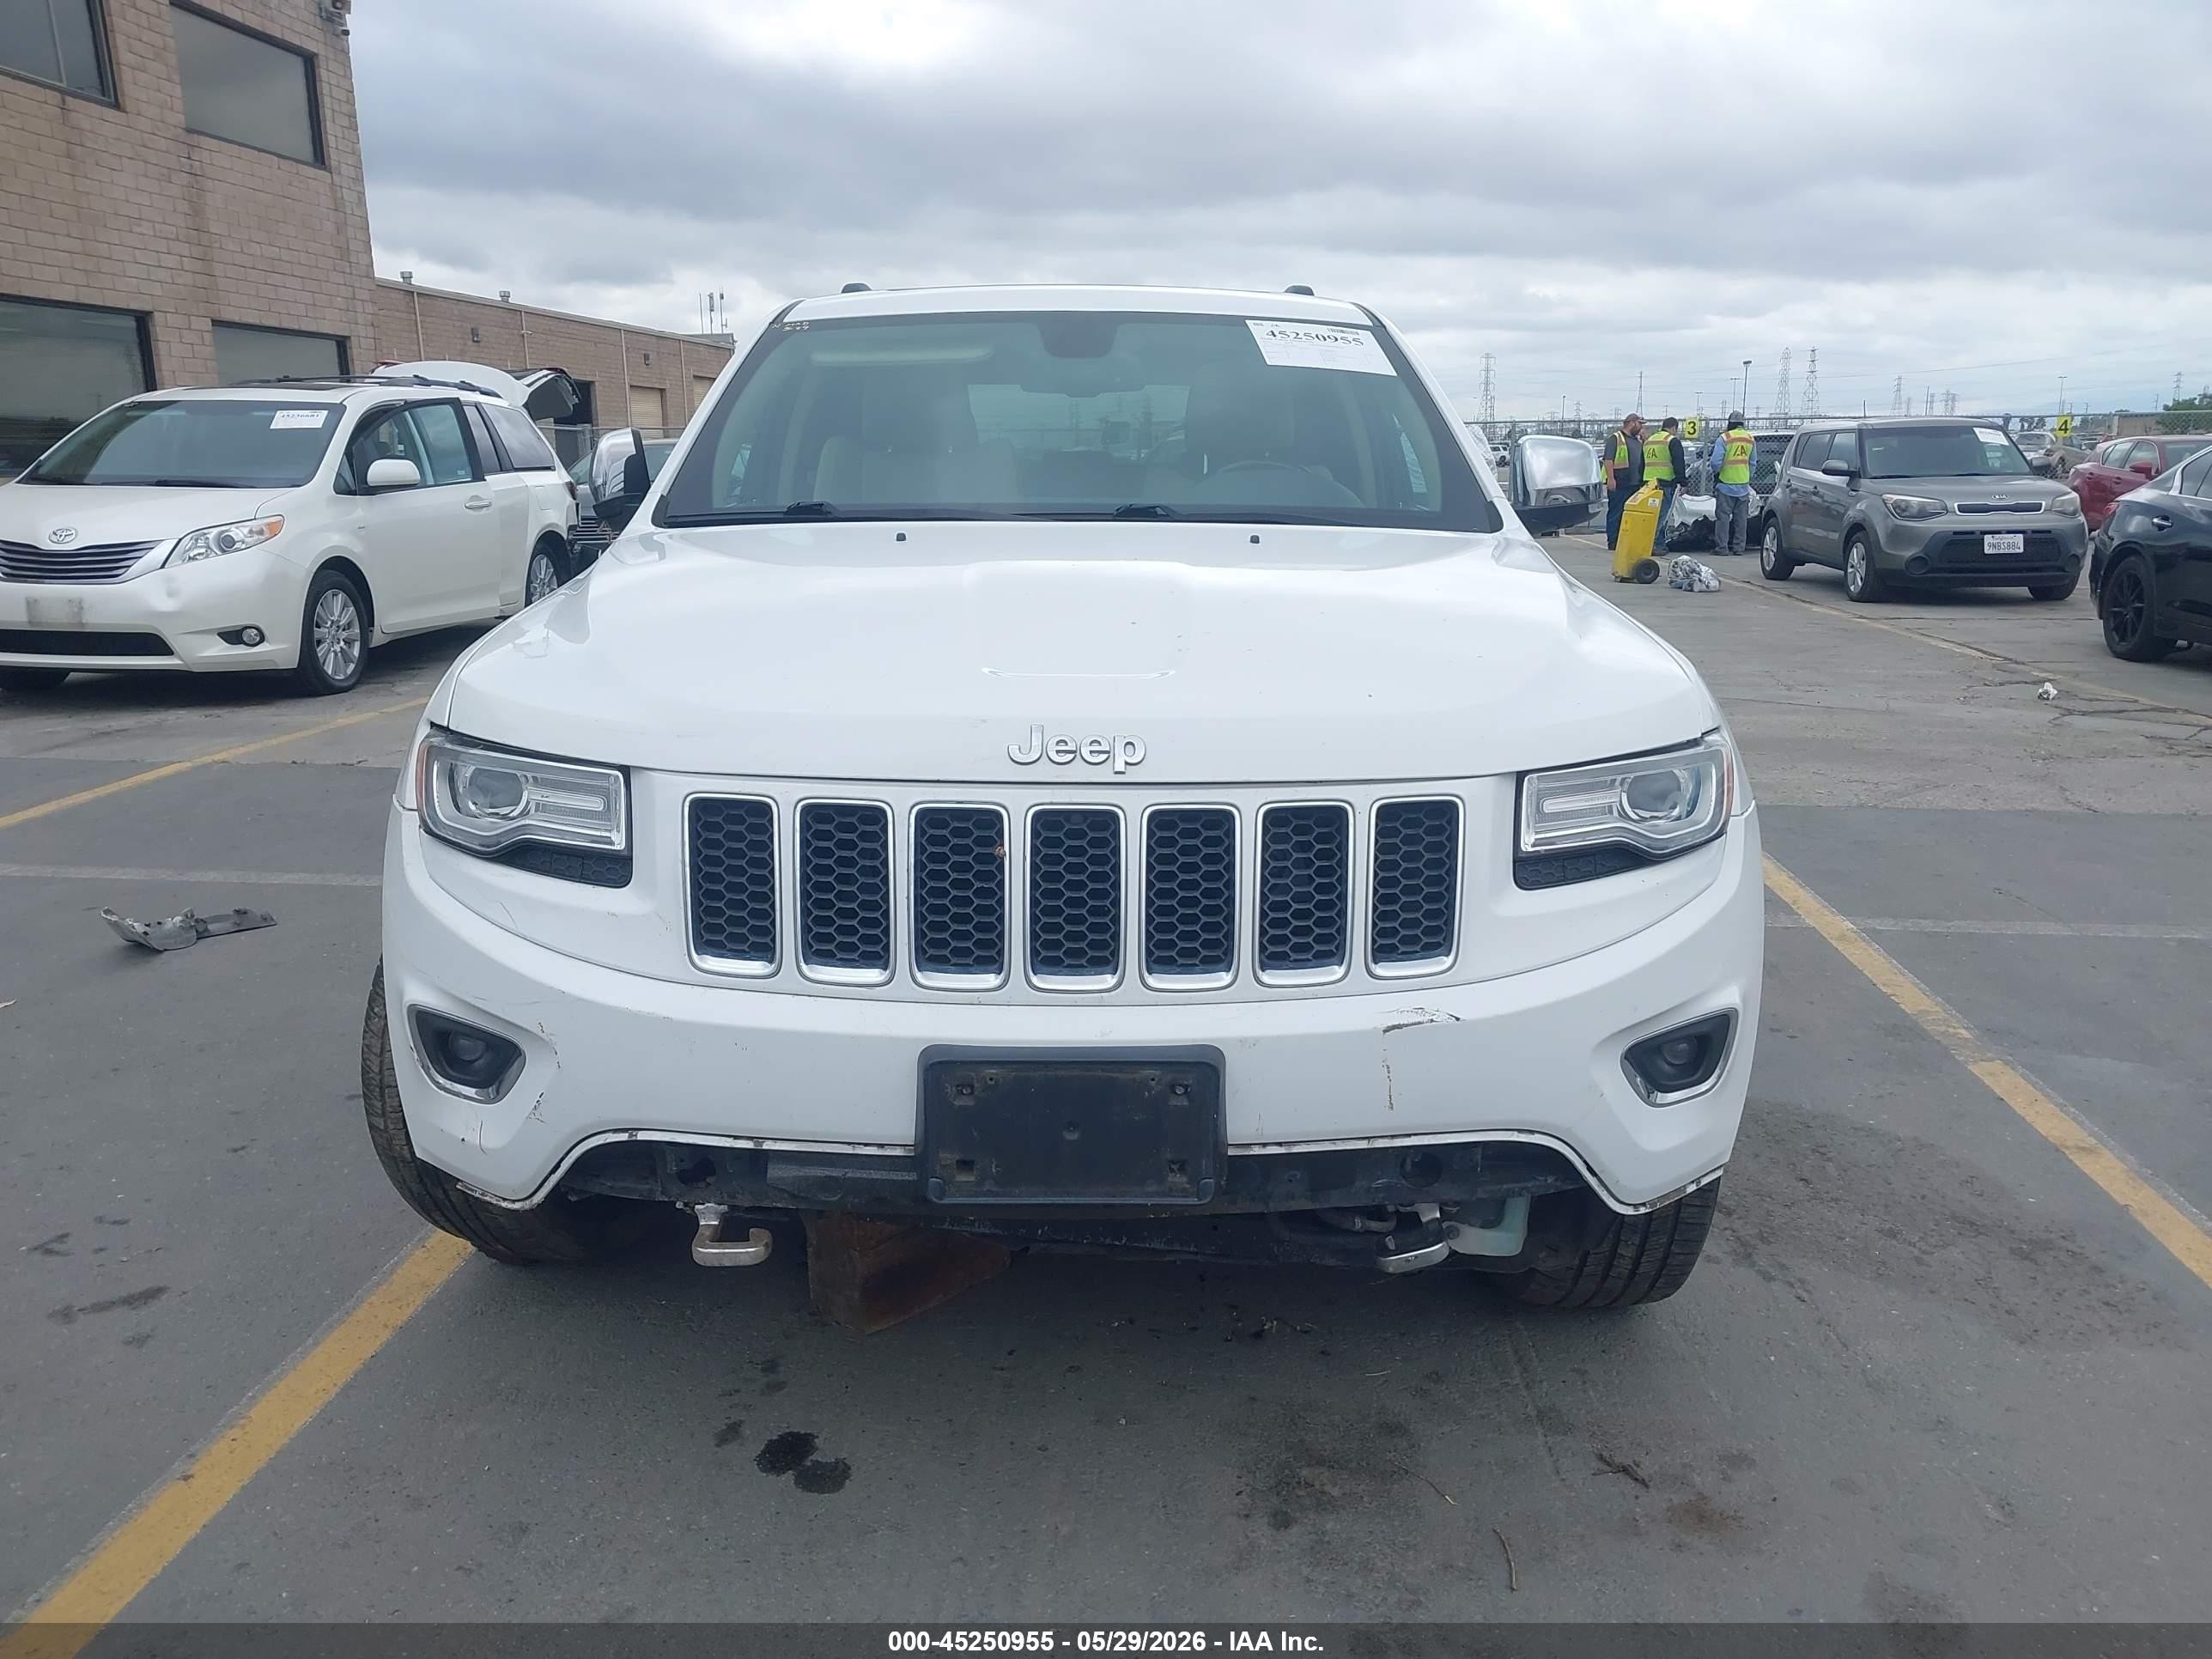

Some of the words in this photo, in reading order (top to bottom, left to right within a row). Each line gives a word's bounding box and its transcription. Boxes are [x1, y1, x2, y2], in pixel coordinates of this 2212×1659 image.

[1265, 329, 1364, 346] 45250955
[1686, 421, 1697, 435] 3
[2058, 419, 2069, 434] 4
[1986, 542, 2021, 550] 9NBS884
[1007, 723, 1147, 775] Jeep
